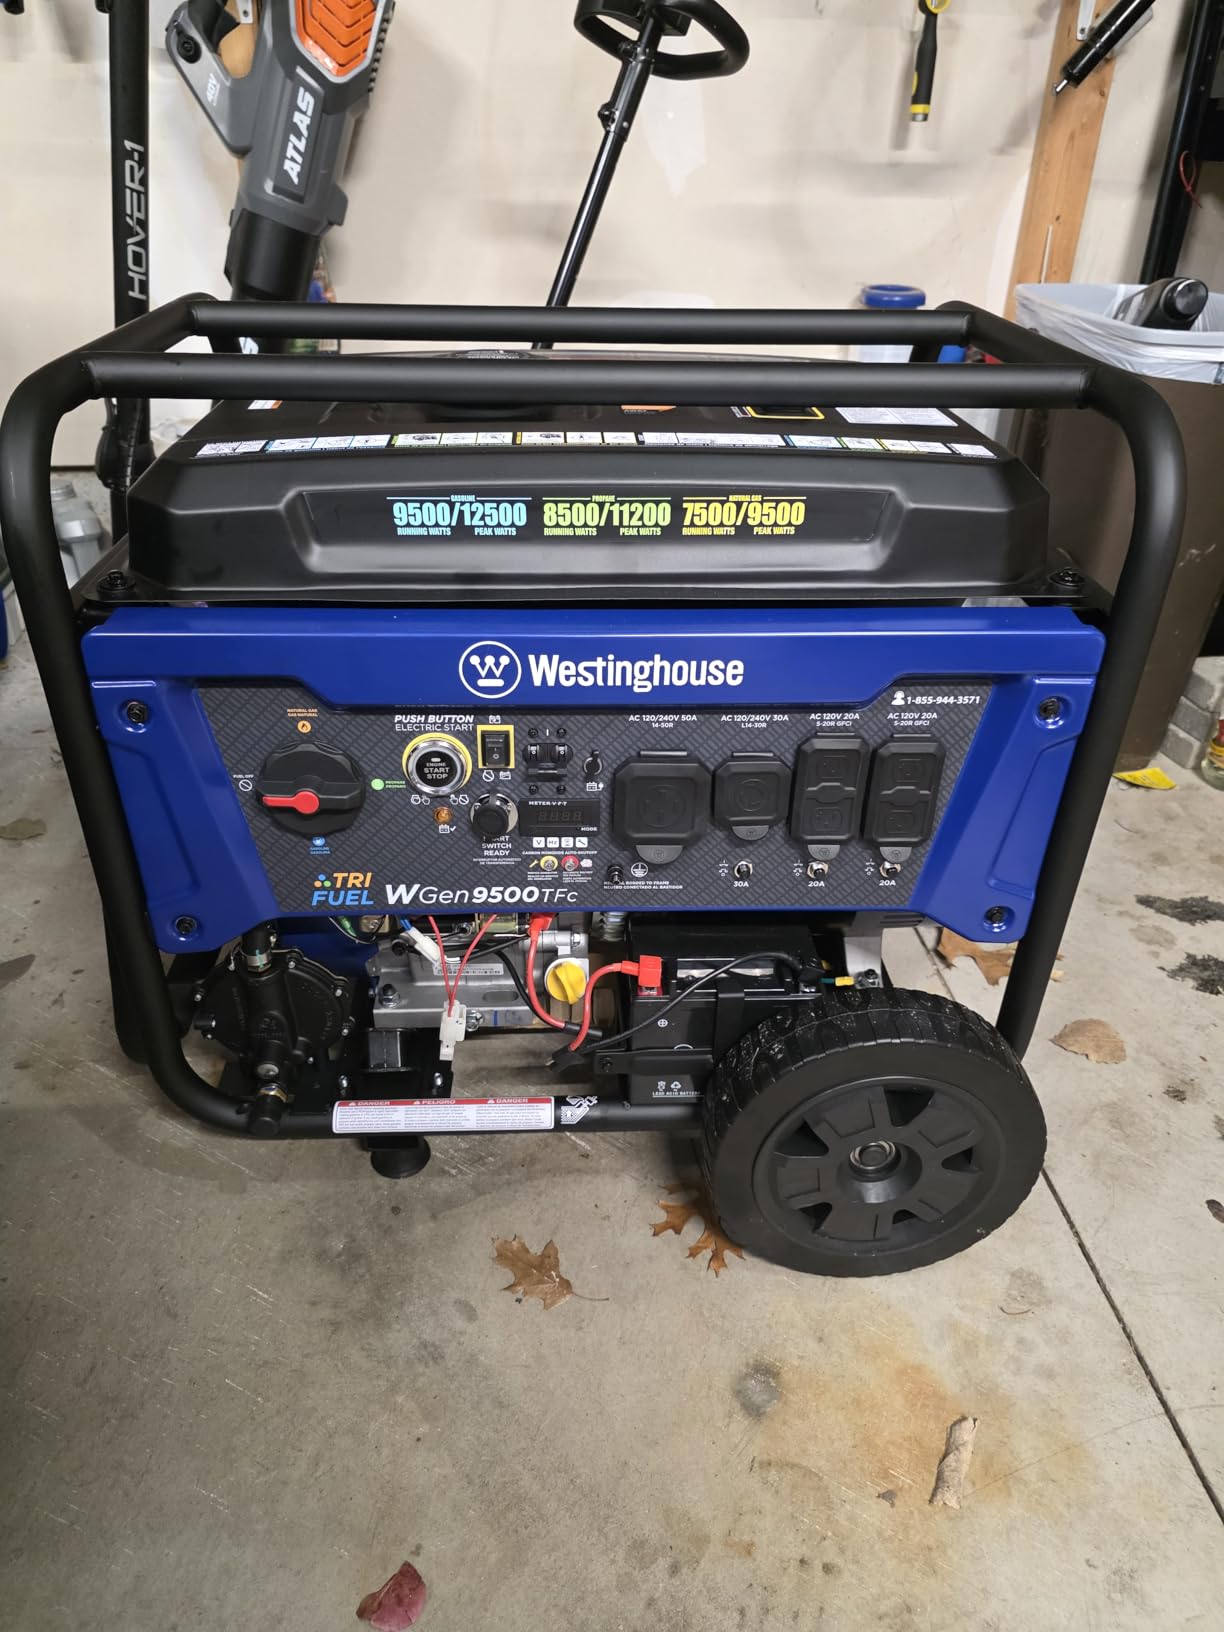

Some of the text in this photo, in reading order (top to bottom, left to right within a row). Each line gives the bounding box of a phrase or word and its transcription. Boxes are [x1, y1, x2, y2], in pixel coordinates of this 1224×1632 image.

[283, 86, 315, 185] ATLAS
[123, 139, 147, 300] HOVER-1
[392, 502, 527, 526] 9500/12500
[543, 502, 672, 526] 8500/11200
[682, 501, 806, 526] 7500/9500
[397, 527, 452, 536] RUNNING WATTS
[474, 527, 517, 536] PEAK WATTS
[543, 527, 597, 536] RUNNING WATTS
[620, 527, 661, 536] PEAK WATTS
[682, 527, 736, 536] RUNNING WATTS
[753, 526, 796, 535] PEAK WATTS
[528, 654, 744, 693] Westinghouse
[906, 695, 980, 705] 1-855-944-3571
[394, 715, 474, 723] PUSH BUTTON
[628, 714, 697, 722] AC 120/240V 50A
[720, 714, 789, 722] AC 120/240V 30A
[395, 723, 474, 731] ELECTRIC START
[332, 872, 372, 889] TRI
[733, 880, 750, 888] 30A
[808, 880, 825, 888] 20A
[879, 879, 897, 887] 20A
[312, 889, 375, 907] FUEL
